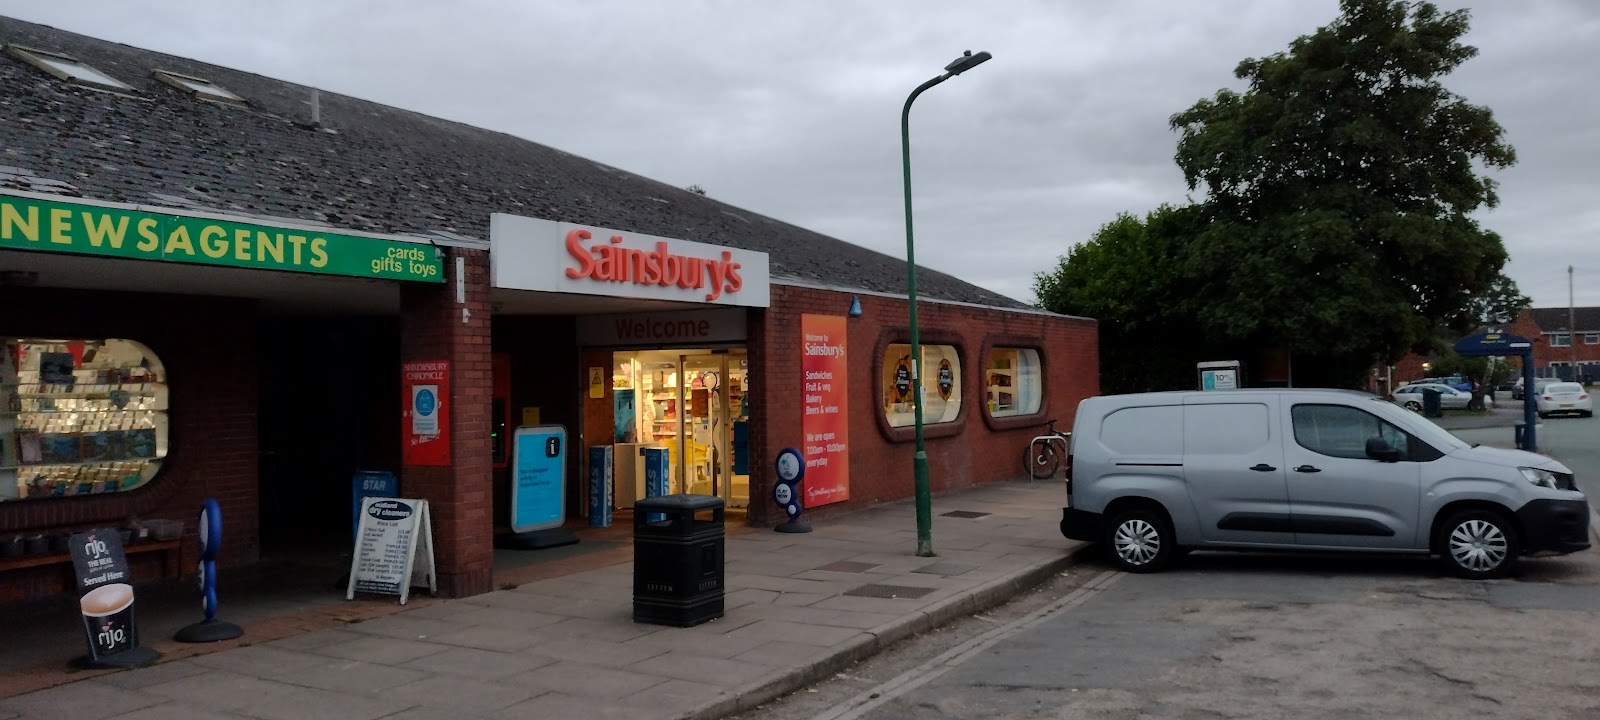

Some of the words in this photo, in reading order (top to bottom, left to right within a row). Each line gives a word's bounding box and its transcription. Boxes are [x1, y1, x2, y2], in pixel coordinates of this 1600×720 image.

[1, 203, 329, 269] NEWSAGENTS
[388, 247, 425, 262] cards
[371, 257, 403, 274] gifts
[409, 260, 437, 278] toys
[565, 229, 743, 302] Sainsbury's
[616, 317, 710, 339] Welcome
[805, 343, 845, 359] Sainsbury's
[407, 371, 444, 380] CHRONICLE
[806, 371, 833, 380] Sandwiches
[806, 383, 817, 392] Fruit
[822, 384, 832, 393] veg
[806, 395, 823, 404] Bakery
[806, 407, 819, 416] Beers
[825, 406, 839, 414] wines
[823, 432, 836, 442] open
[807, 457, 828, 468] everyday
[363, 479, 387, 491] STAR
[591, 467, 600, 508] STAR
[648, 468, 657, 499] STA
[369, 506, 382, 516] dry
[84, 572, 107, 587] Served
[107, 571, 124, 581] Here
